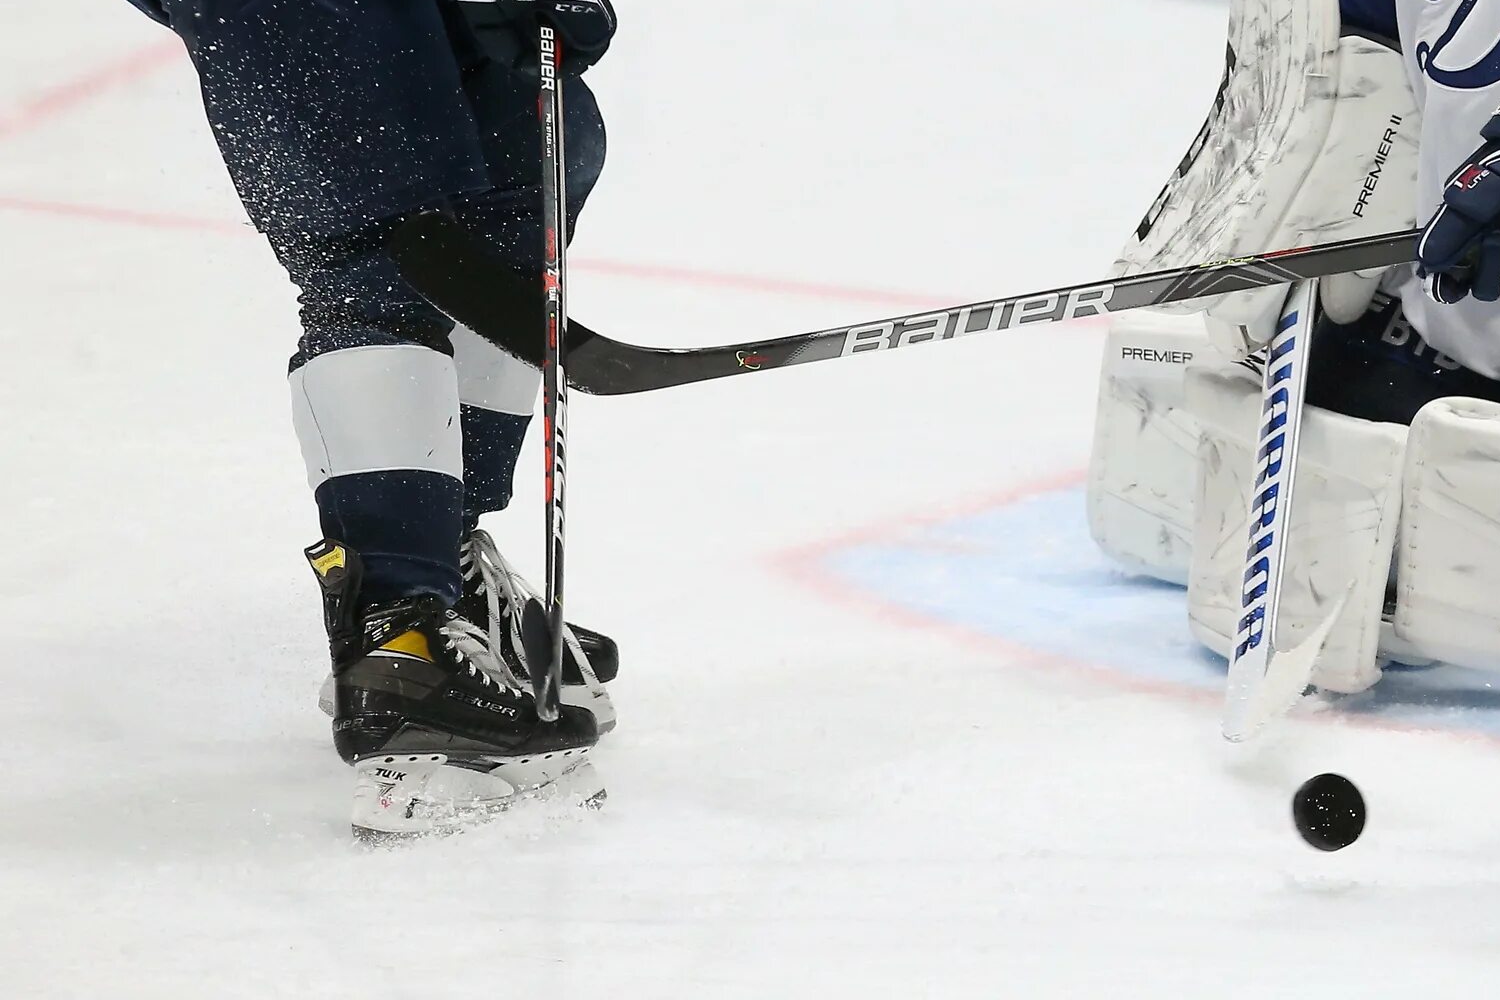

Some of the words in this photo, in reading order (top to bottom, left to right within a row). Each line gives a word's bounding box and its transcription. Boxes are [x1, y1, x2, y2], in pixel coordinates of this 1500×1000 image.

[1353, 127, 1397, 218] PREMIER
[840, 282, 1118, 358] BAUER
[1234, 310, 1299, 665] WARRIOR
